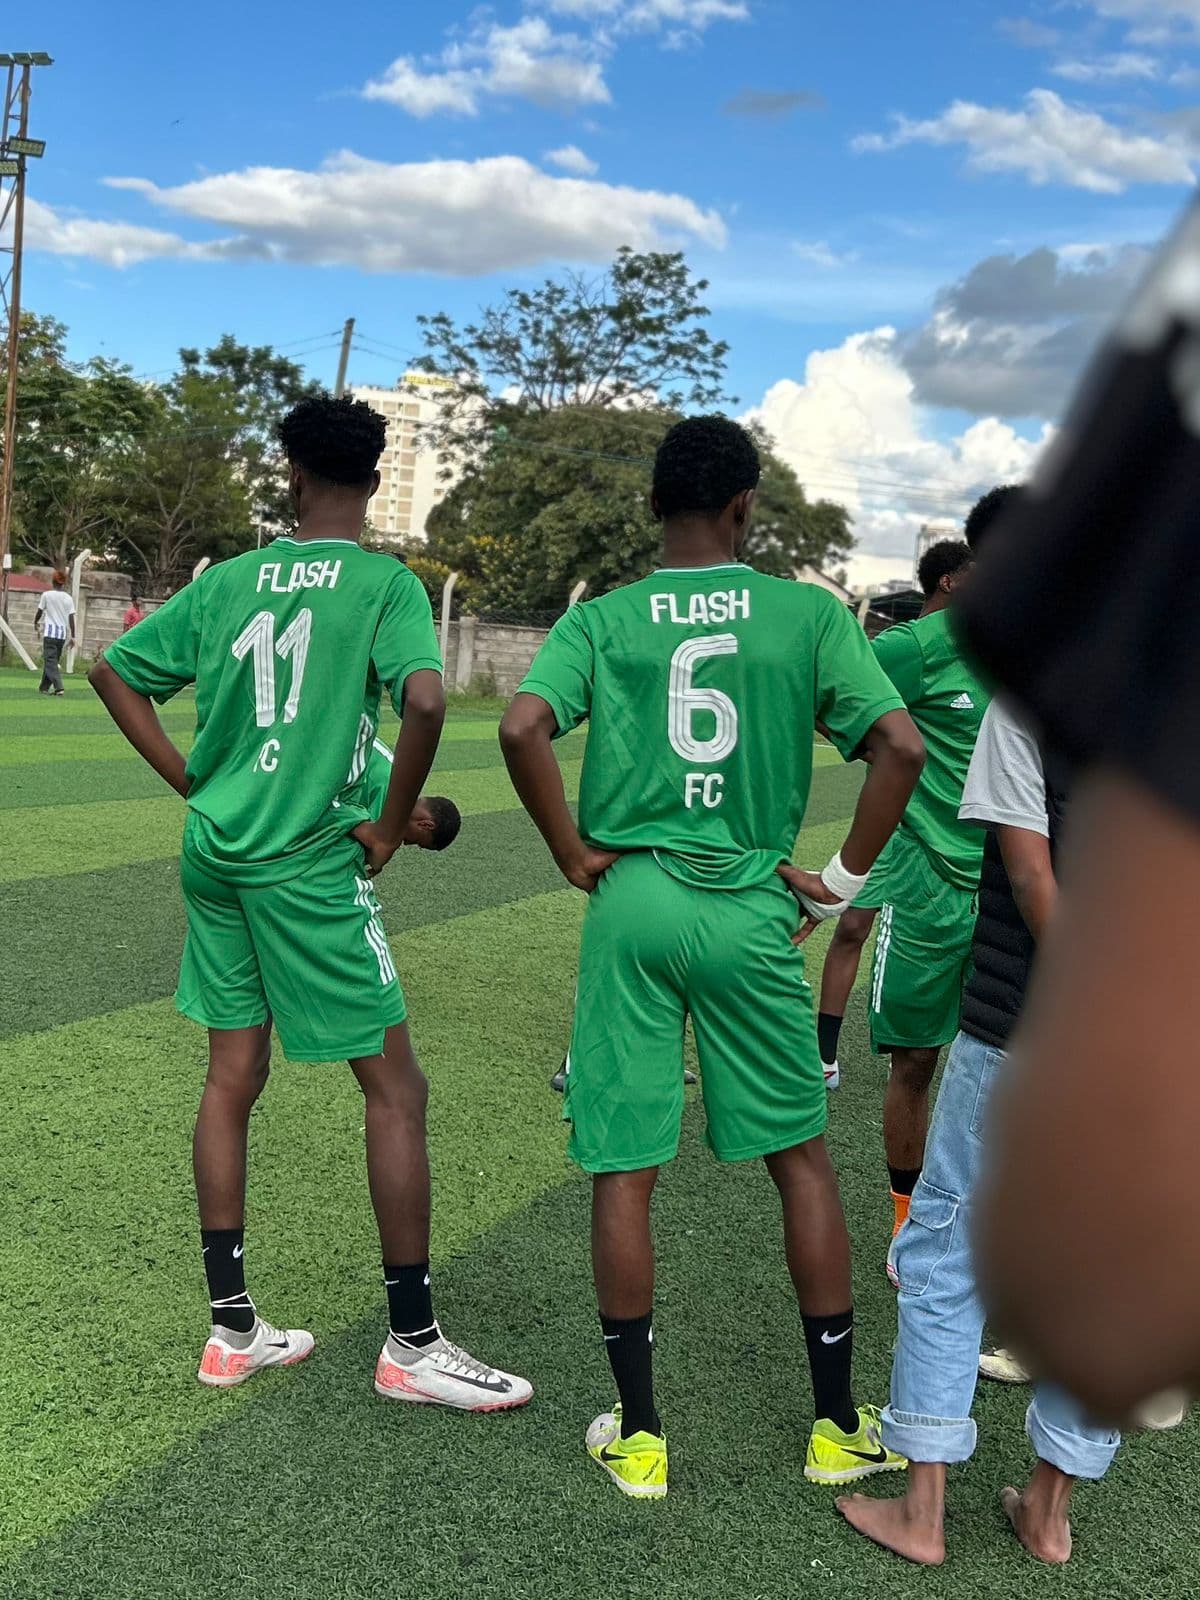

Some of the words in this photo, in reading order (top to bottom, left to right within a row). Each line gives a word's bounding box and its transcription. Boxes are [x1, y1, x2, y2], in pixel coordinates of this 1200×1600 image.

[256, 560, 341, 592] FLASH
[650, 589, 749, 624] FLASH
[232, 608, 312, 727] 11
[668, 633, 738, 763] 6
[253, 738, 280, 772] C
[684, 773, 724, 809] FC
